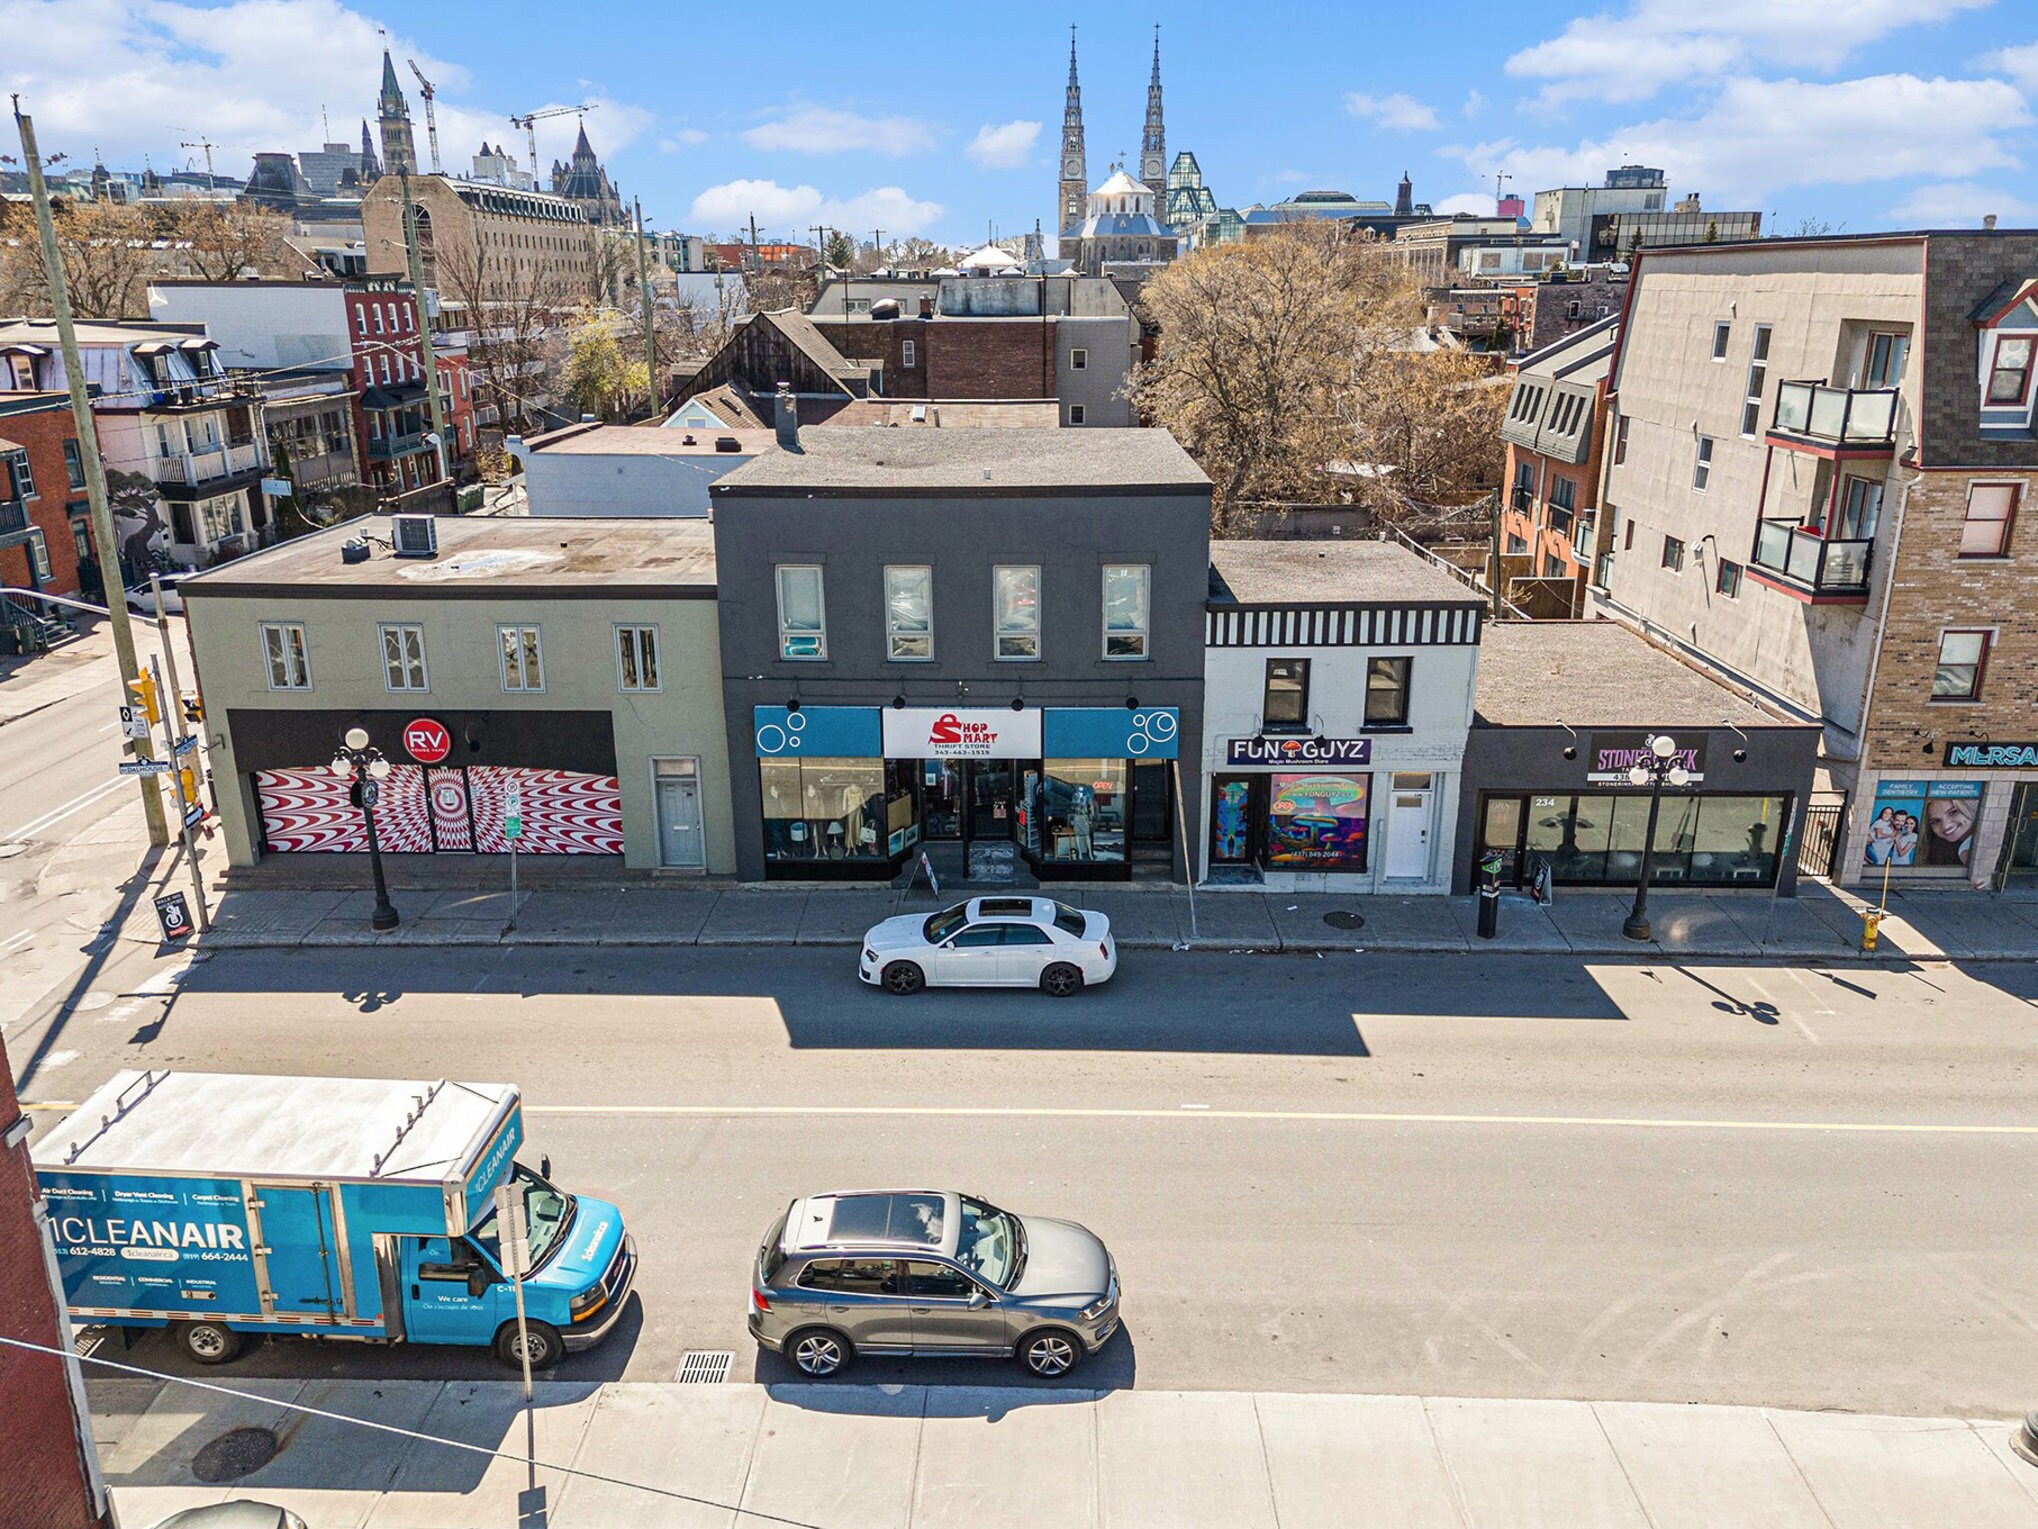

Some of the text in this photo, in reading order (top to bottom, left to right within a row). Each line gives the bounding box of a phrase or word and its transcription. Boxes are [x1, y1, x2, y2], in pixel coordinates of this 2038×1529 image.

[408, 731, 443, 748] RV
[1233, 741, 1364, 759] FUN GUYZ
[1950, 746, 2038, 765] MERSA
[1882, 789, 1918, 797] DENTISTRY
[1535, 798, 1555, 806] 234
[48, 1216, 246, 1250] 1CLEANAIR
[70, 1247, 116, 1256] 612-4828
[201, 1252, 249, 1261] 664-2444
[437, 1295, 451, 1303] We
